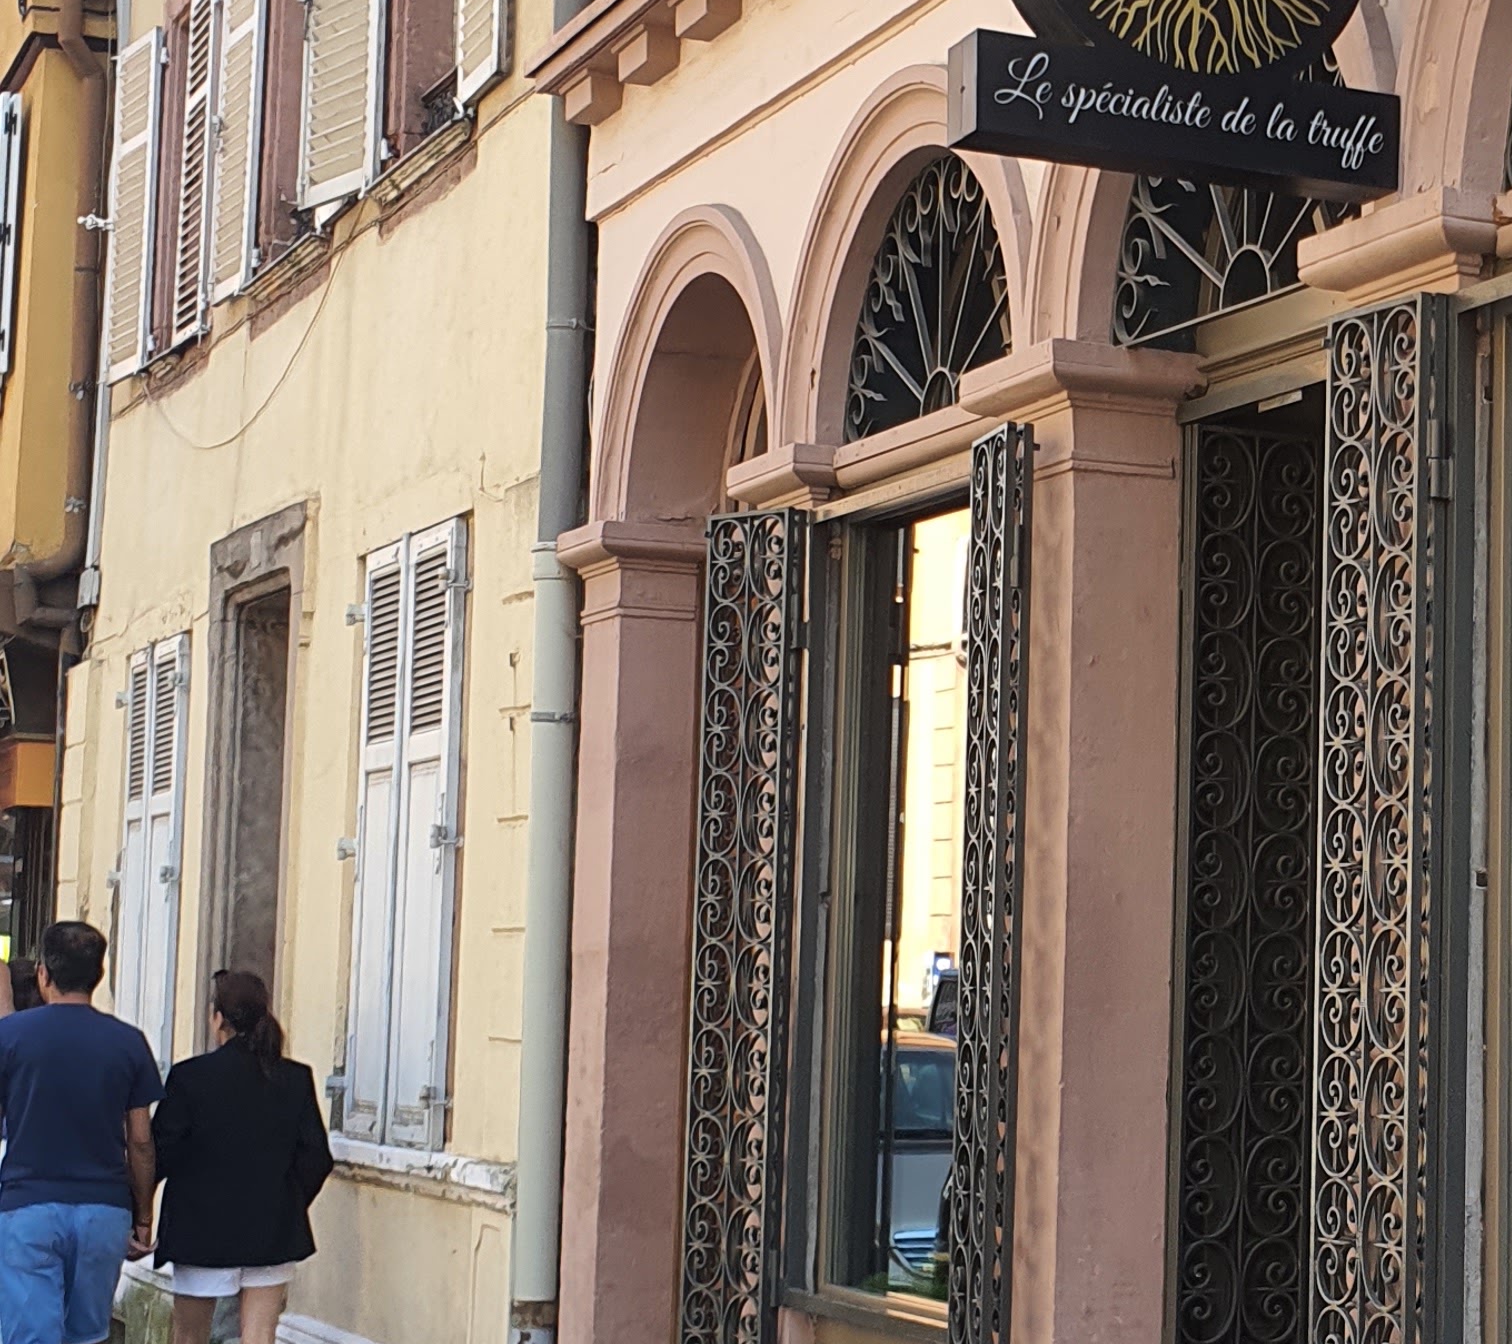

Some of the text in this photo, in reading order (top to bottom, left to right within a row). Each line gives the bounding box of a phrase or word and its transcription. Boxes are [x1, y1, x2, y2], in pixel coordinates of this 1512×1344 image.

[993, 52, 1385, 171] Le spécialiste de la truffe
